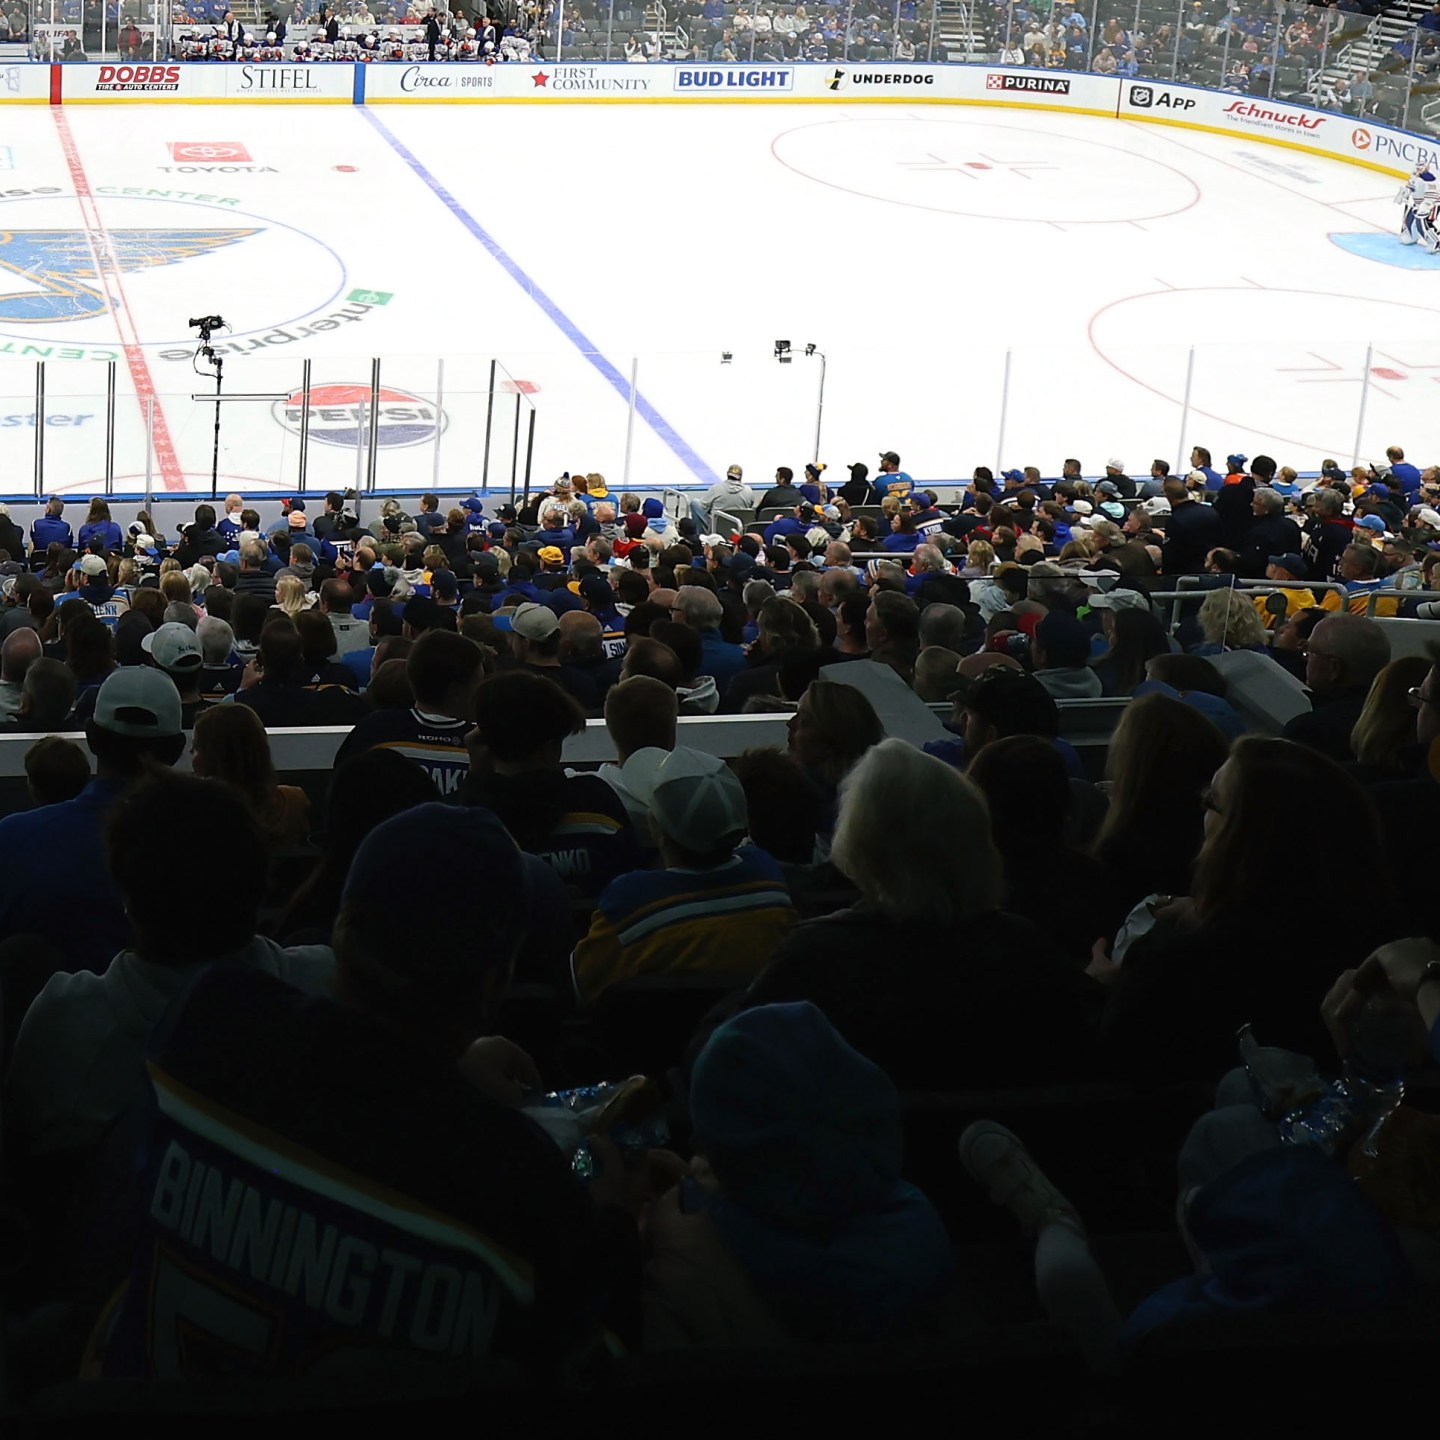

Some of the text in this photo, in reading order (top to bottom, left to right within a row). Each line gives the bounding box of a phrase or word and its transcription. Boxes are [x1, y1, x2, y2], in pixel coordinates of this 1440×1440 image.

[98, 66, 180, 83] DOBBS
[241, 65, 317, 89] STIFEL
[400, 66, 493, 92] Circa SPORTS
[553, 68, 597, 79] FIRST
[679, 71, 790, 88] BUD LIGHT
[853, 73, 934, 85] UNDERDOG
[98, 83, 177, 91] TIRE AUTO CENTERS
[552, 78, 651, 91] COMMUNITY
[1005, 77, 1068, 92] PURINA
[1222, 101, 1327, 129] Schnucks
[1226, 114, 1238, 122] The
[1375, 135, 1414, 162] PNC
[156, 166, 280, 174] TOYOTA
[95, 185, 242, 207] CENTER
[285, 407, 436, 424] PEPSI
[149, 1139, 502, 1358] BINNINGTON
